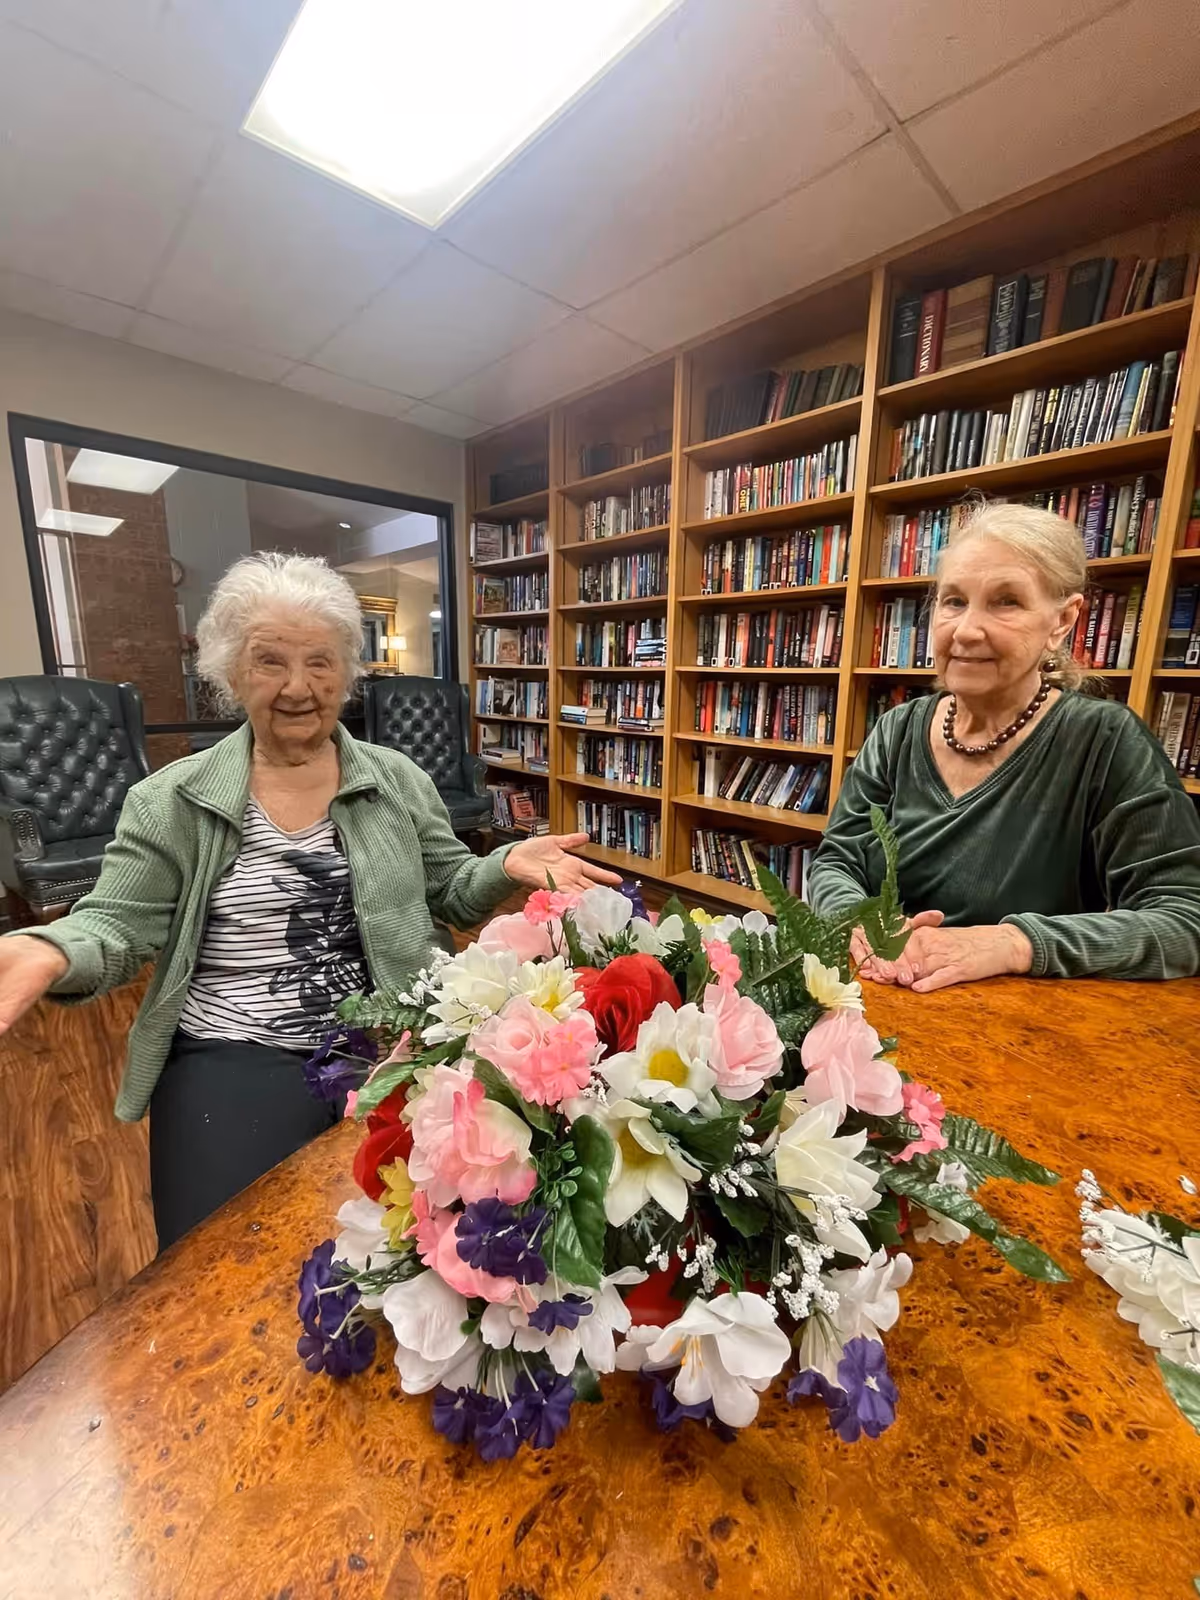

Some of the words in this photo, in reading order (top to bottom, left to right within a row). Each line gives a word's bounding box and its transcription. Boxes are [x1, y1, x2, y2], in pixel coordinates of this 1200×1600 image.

[919, 314, 935, 373] DICTIONARY
[1086, 620, 1096, 638] NAKED
[1085, 638, 1093, 648] EYE
